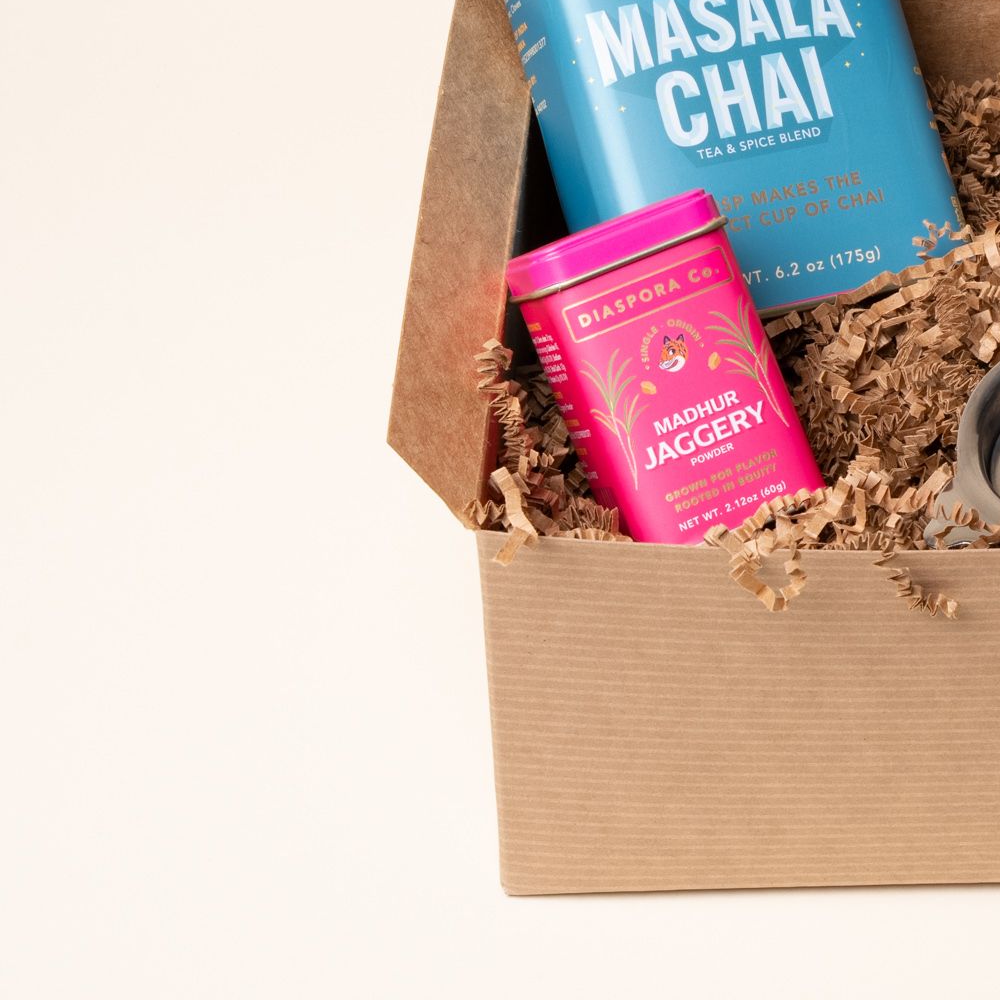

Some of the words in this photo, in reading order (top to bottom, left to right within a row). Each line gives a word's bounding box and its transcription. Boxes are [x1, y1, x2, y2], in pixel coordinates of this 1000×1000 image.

[655, 45, 834, 148] CHAI
[696, 147, 723, 161] TEA
[726, 143, 737, 154] &
[739, 135, 776, 152] SPICE
[779, 126, 821, 145] BLEND
[720, 195, 744, 212] SP
[751, 179, 820, 207] MAKES
[824, 171, 863, 193] THE
[759, 203, 798, 227] CUP
[804, 199, 830, 218] OF
[837, 187, 885, 211] CHAI
[775, 262, 801, 279] 6.2
[806, 259, 825, 273] oz
[830, 245, 881, 270] (175g)
[577, 278, 681, 328] DIASPORA
[688, 267, 720, 283] Co.
[640, 325, 659, 363] SINGLE
[666, 318, 702, 342] ORIGIN
[644, 400, 765, 471] JAGGERY
[652, 390, 740, 436] MADHUR
[665, 478, 708, 503] GROWN
[710, 467, 733, 485] FOR
[735, 449, 778, 472] FLAVOR
[690, 442, 735, 467] POWDER
[674, 489, 720, 514] ROOTED
[722, 483, 735, 493] IN
[737, 463, 777, 487] EQUITY
[678, 516, 700, 532] NET
[702, 506, 723, 522] WT.
[724, 494, 759, 513] 2.12oz
[760, 479, 787, 498] (60g)
